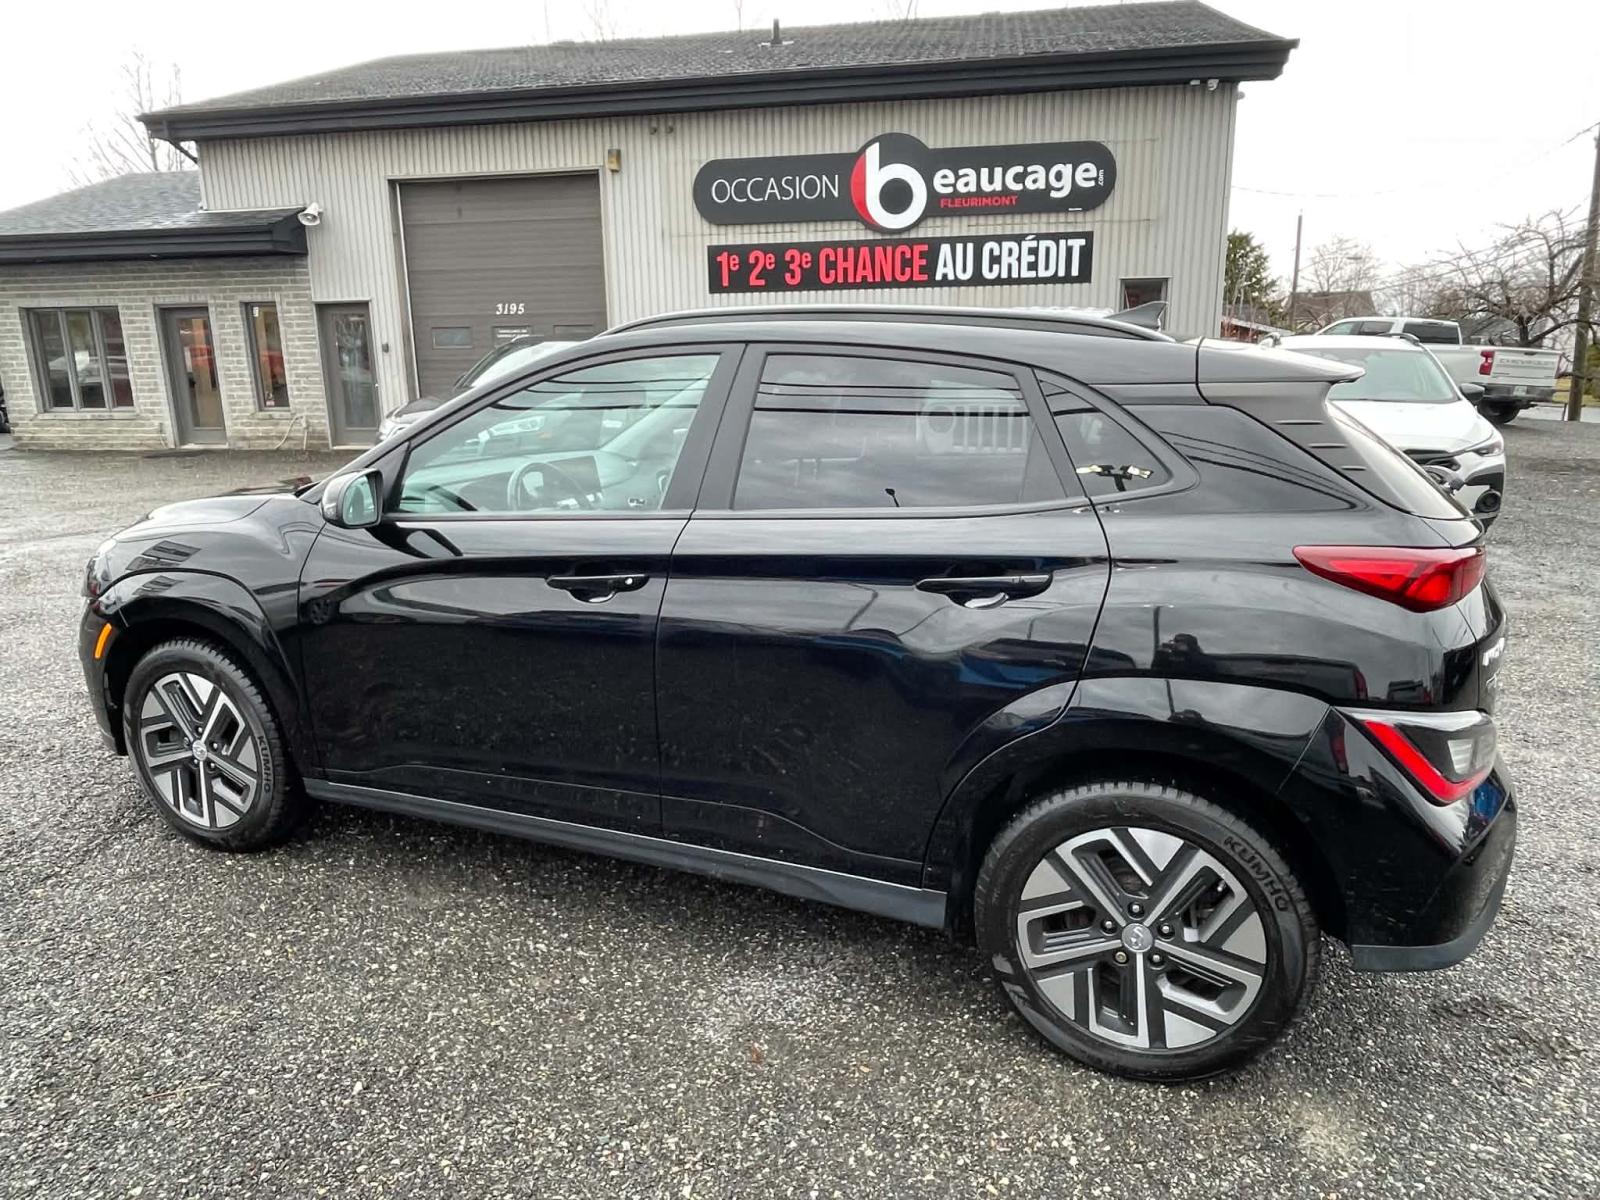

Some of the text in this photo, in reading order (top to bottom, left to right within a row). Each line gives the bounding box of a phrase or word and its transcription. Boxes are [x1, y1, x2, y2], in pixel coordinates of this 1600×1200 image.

[711, 174, 839, 203] OCCASION
[940, 195, 1018, 209] FLEURIMONT
[716, 235, 1087, 287] 1e 2e 3e CHANCE AU CRÉDIT
[495, 303, 525, 315] 3195
[257, 735, 271, 794] KUMHO
[1224, 836, 1288, 911] KUMHO
